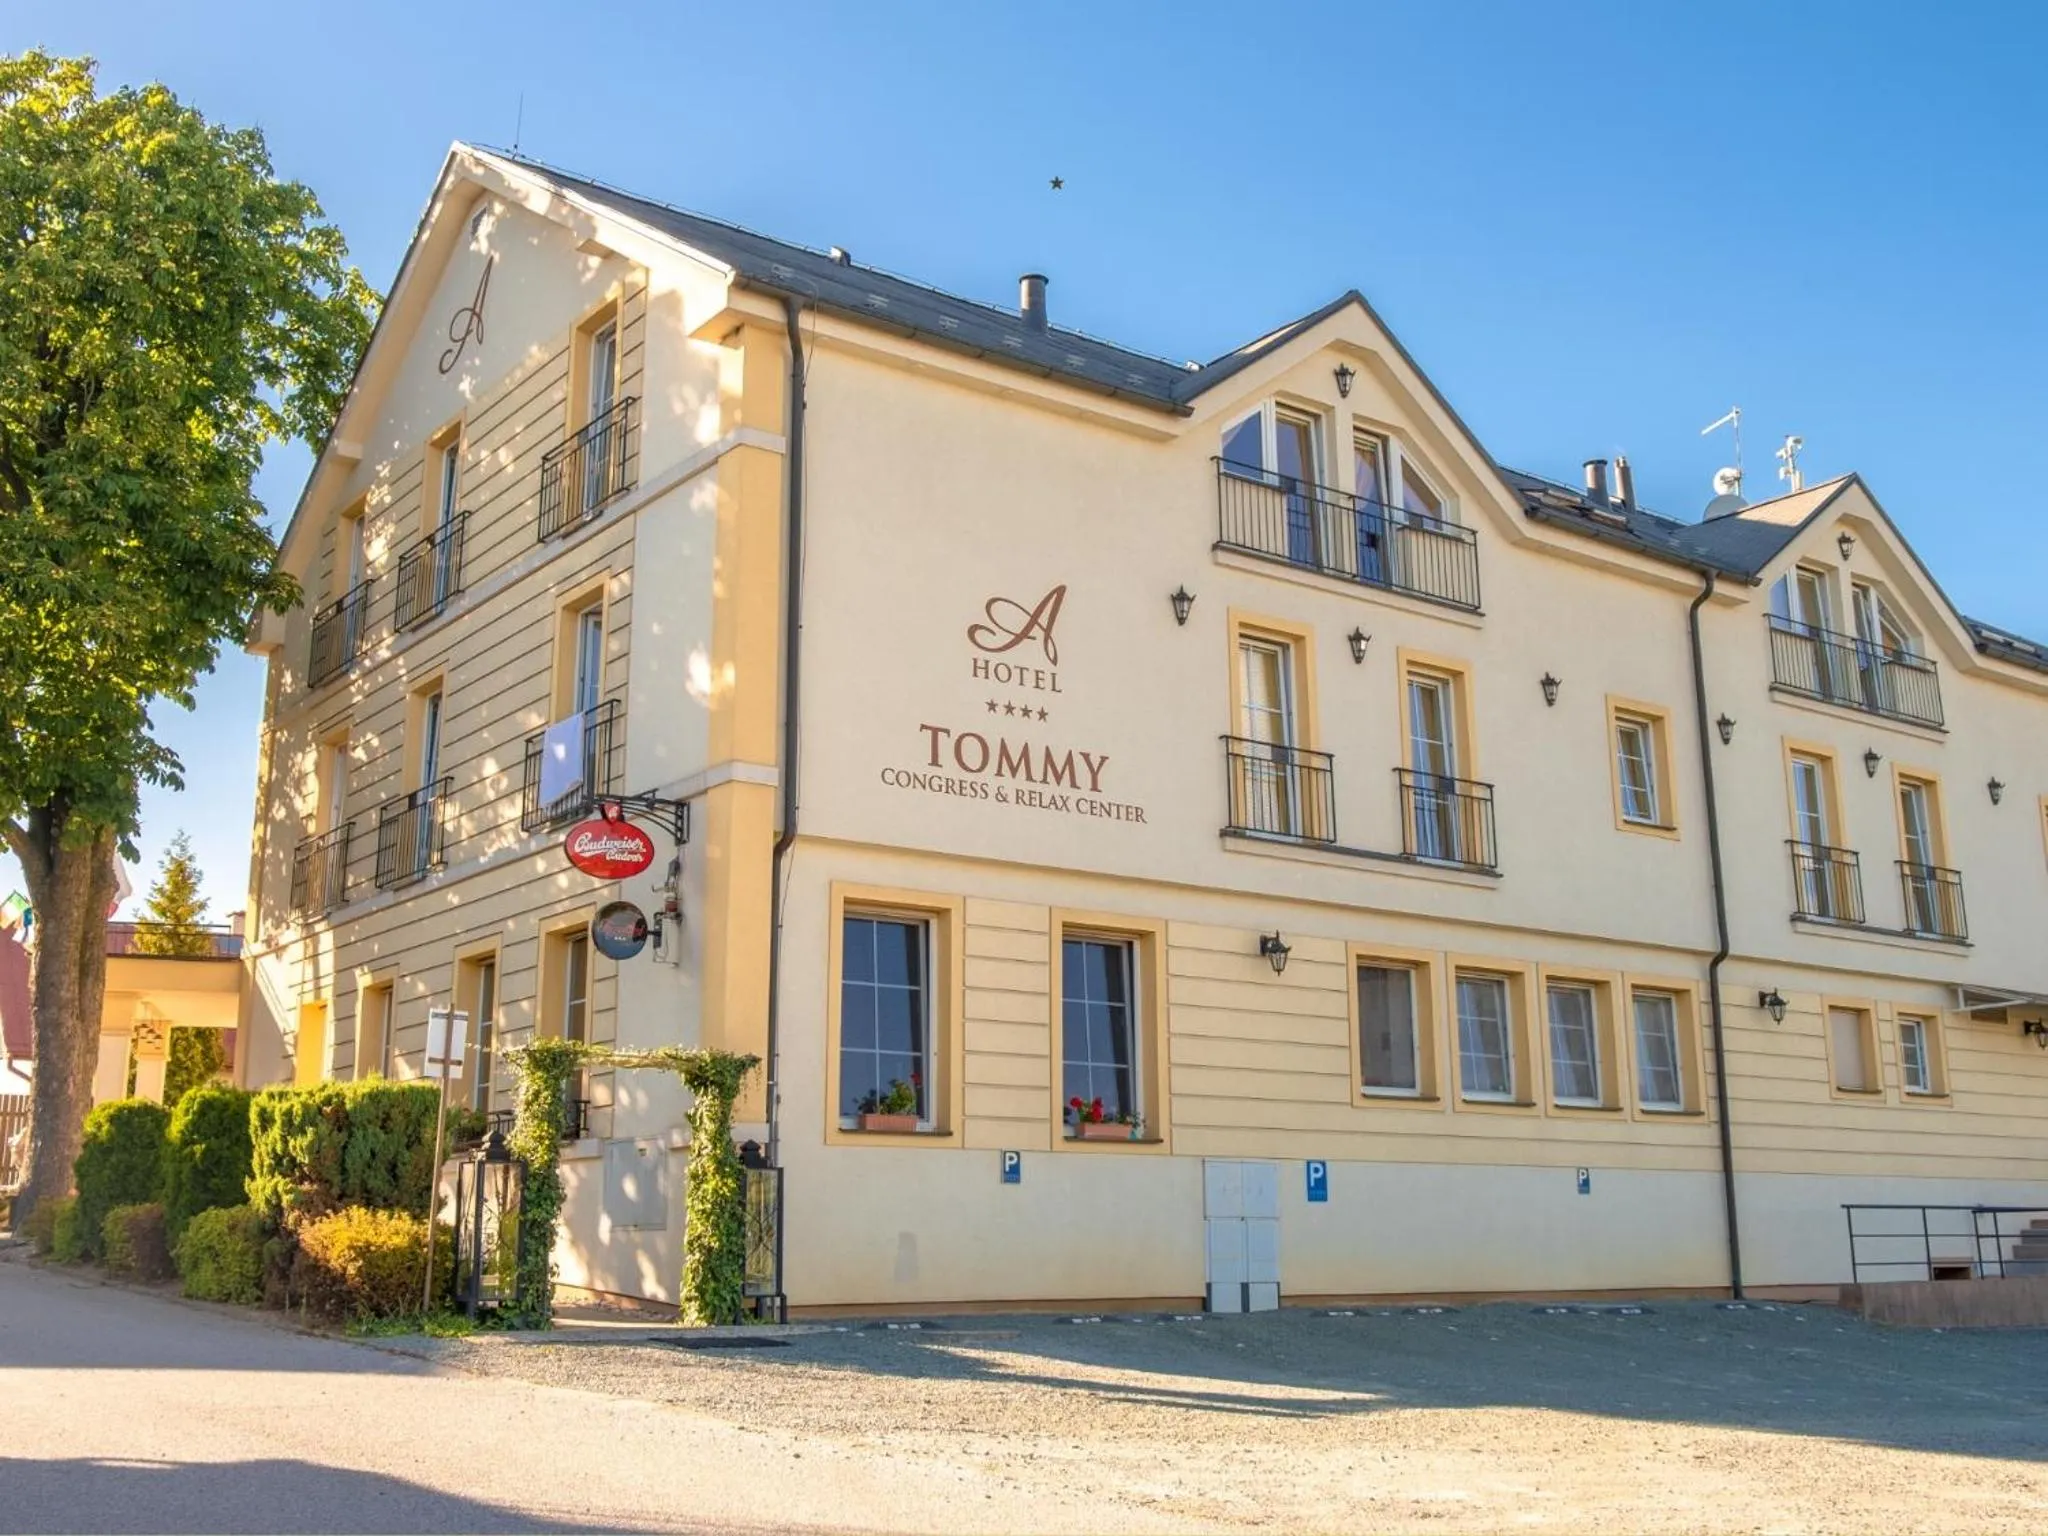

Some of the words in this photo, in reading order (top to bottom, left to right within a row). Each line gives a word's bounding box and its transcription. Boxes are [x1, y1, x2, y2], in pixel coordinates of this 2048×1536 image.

[971, 657, 1062, 693] HOTEL
[919, 723, 1110, 793] TOMMY
[880, 767, 989, 800] CONGRESS
[994, 785, 1010, 803] &
[1014, 787, 1071, 812] RELAX
[1075, 797, 1148, 824] CENTER
[574, 832, 647, 853] Budweiser
[1005, 1151, 1018, 1172] P
[1310, 1162, 1324, 1187] P
[1579, 1168, 1588, 1184] P
